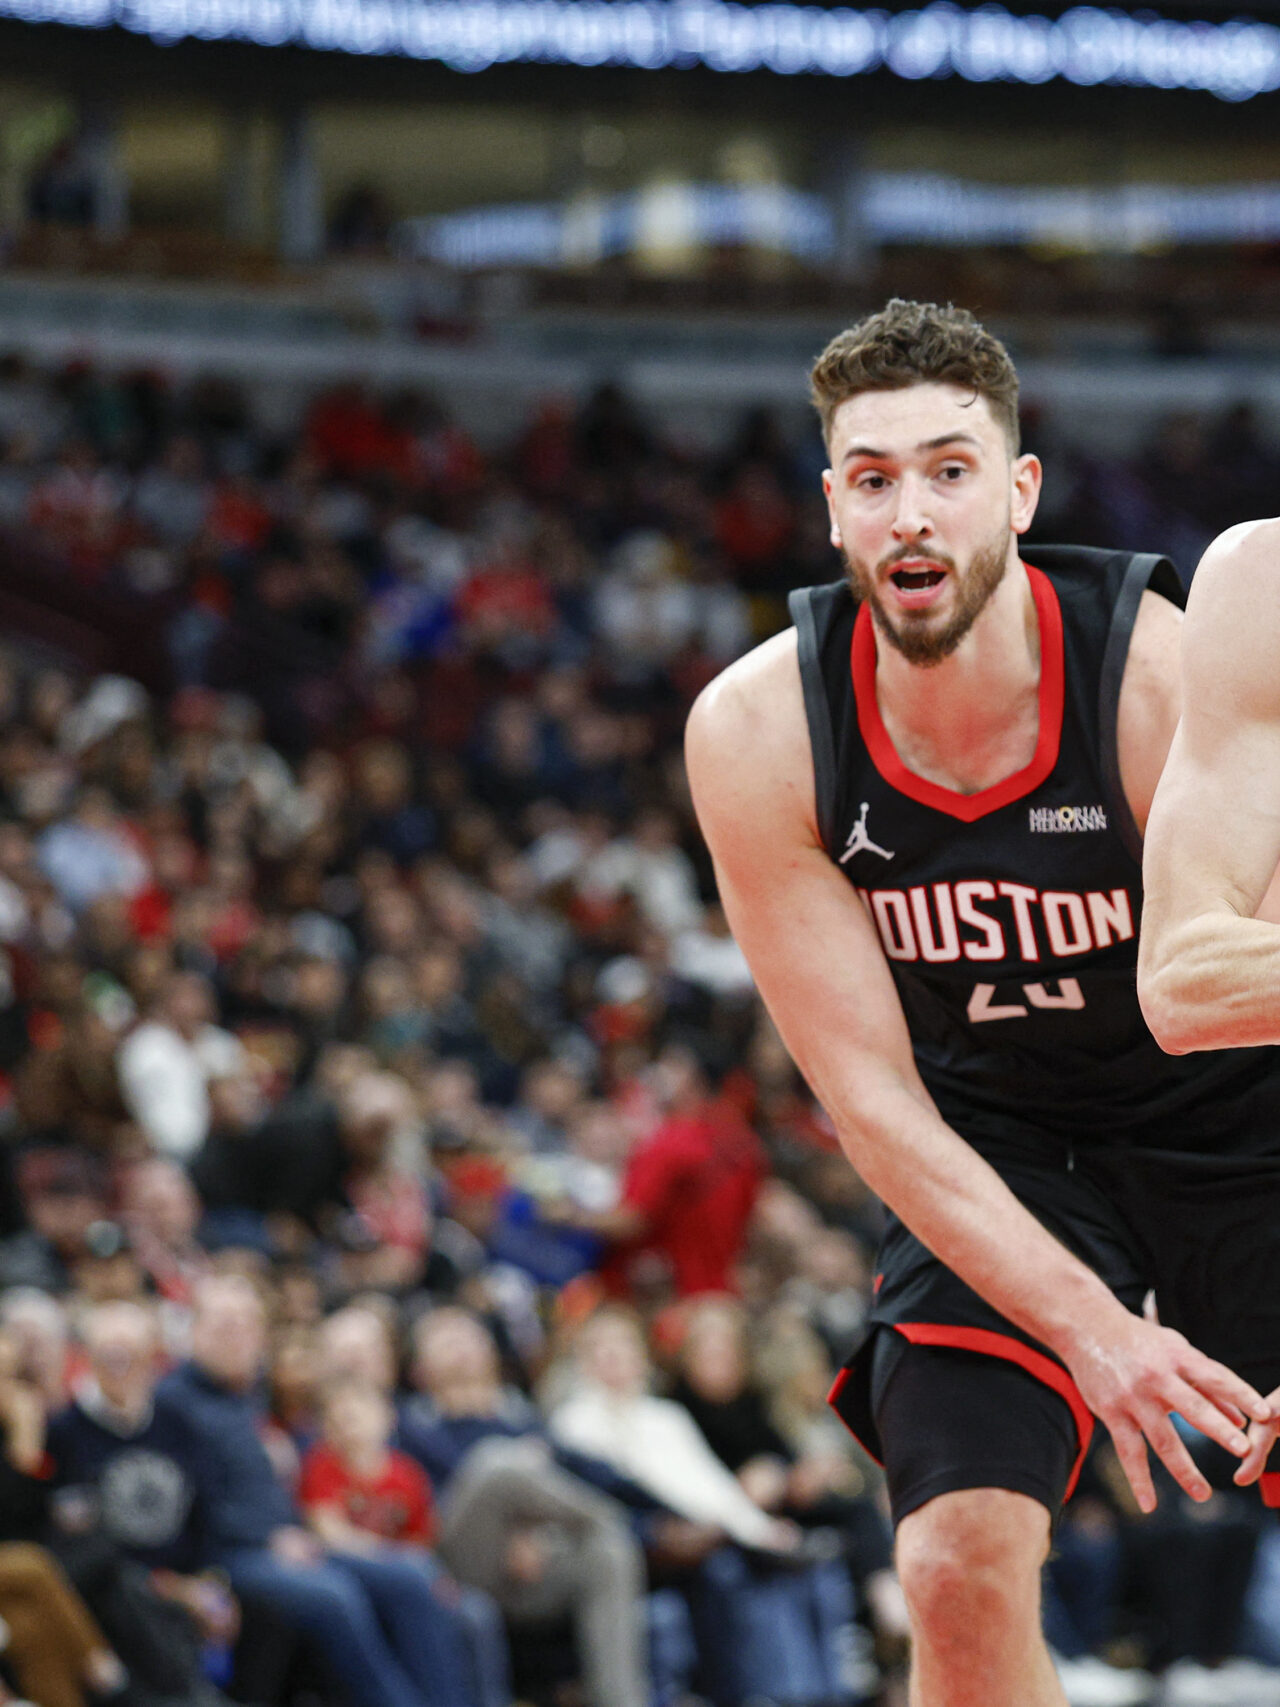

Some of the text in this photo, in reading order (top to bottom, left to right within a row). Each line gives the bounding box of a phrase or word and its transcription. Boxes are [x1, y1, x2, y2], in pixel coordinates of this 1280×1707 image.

[1029, 805, 1106, 821] MEMORIAL
[1029, 817, 1107, 833] HERMANN
[857, 880, 1135, 963] OUSTON
